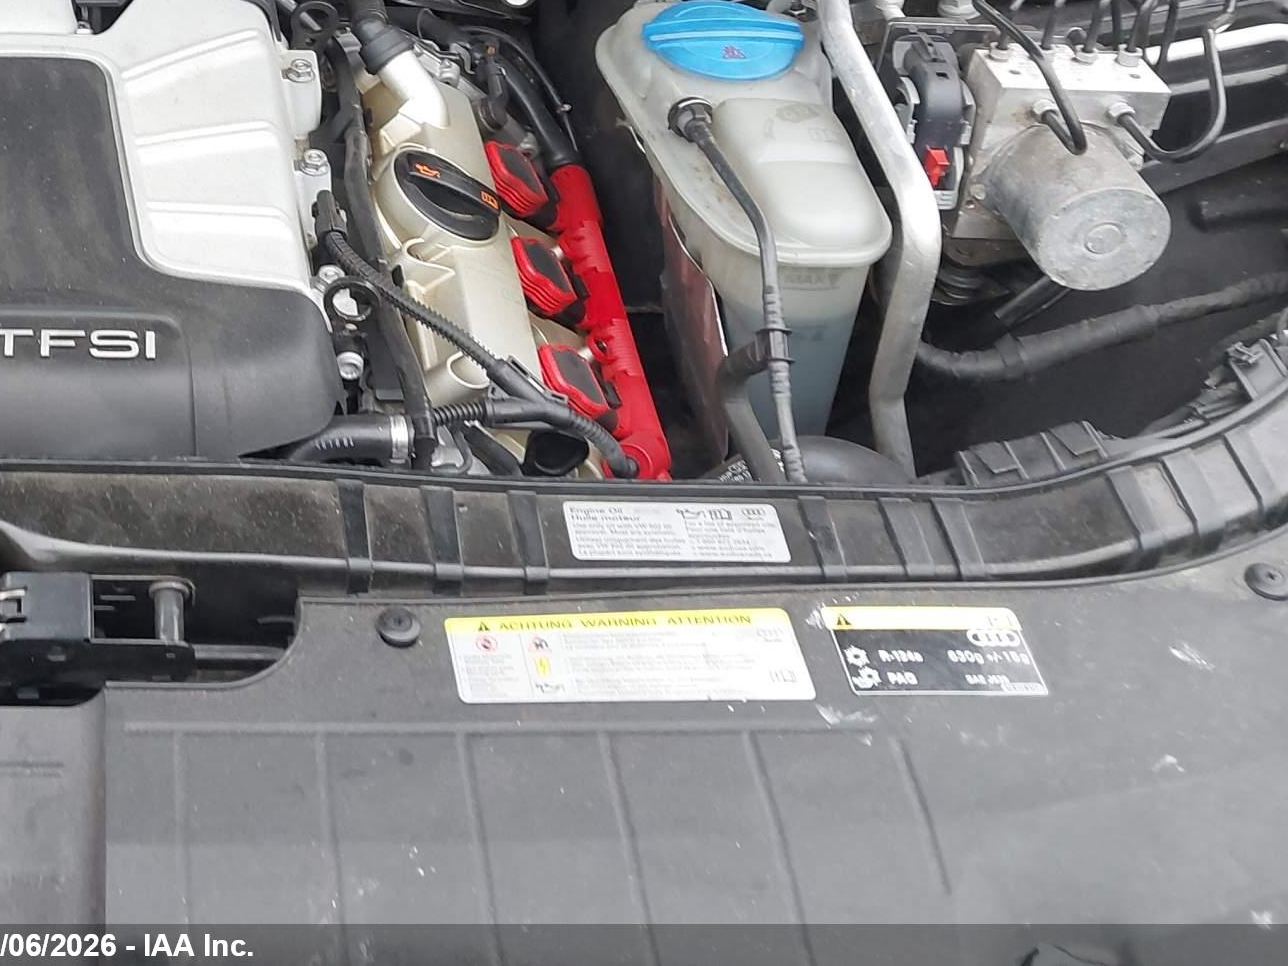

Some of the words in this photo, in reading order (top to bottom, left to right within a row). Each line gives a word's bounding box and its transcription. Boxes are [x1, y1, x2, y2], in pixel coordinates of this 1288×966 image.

[569, 506, 605, 515] Engine
[500, 619, 573, 630] ACHTUNG
[580, 617, 657, 628] WARNING
[667, 615, 752, 626] ATTENTION
